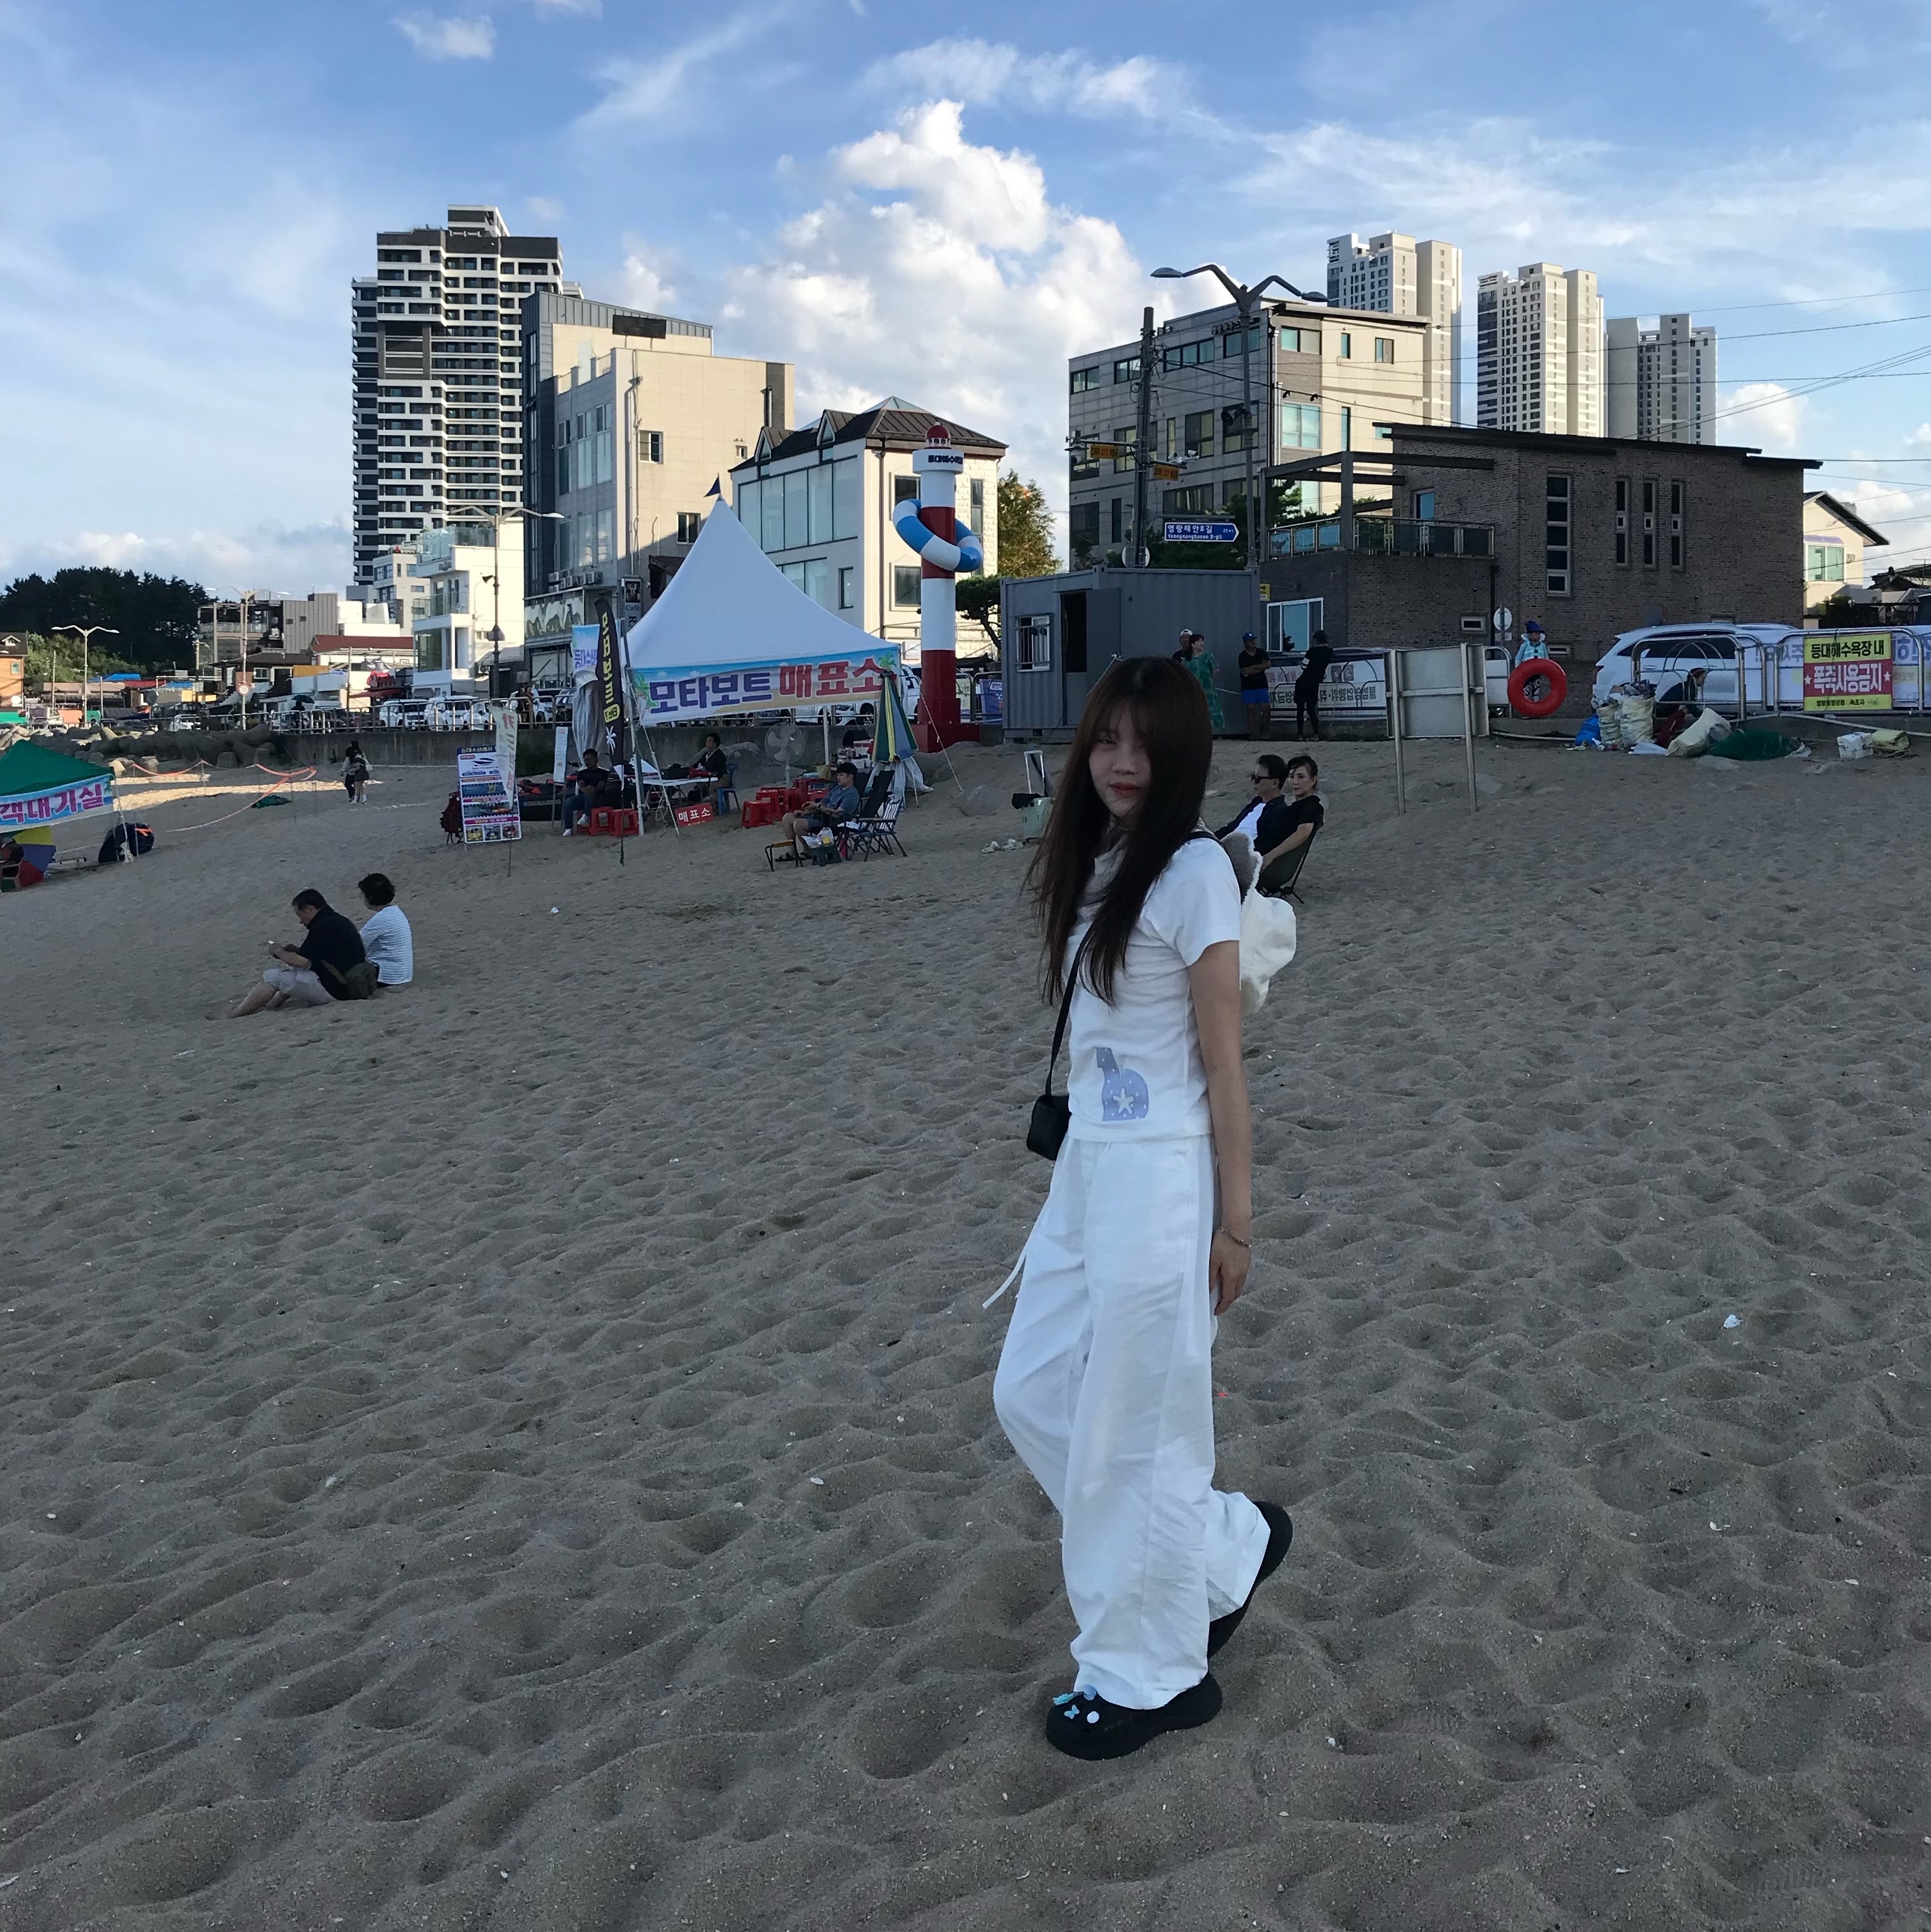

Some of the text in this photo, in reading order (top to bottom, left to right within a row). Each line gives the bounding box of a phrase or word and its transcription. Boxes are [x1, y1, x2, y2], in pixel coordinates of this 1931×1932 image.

[1167, 524, 1212, 534] 영랑해안8길
[1811, 640, 1872, 659] 등대해수욕장
[1874, 640, 1884, 655] 내
[649, 672, 772, 714] 모타보트
[779, 658, 886, 698] 매표소
[1813, 662, 1882, 694] 폭죽사용금지
[0, 783, 104, 823] 객대기실
[678, 807, 711, 822] 매표소
